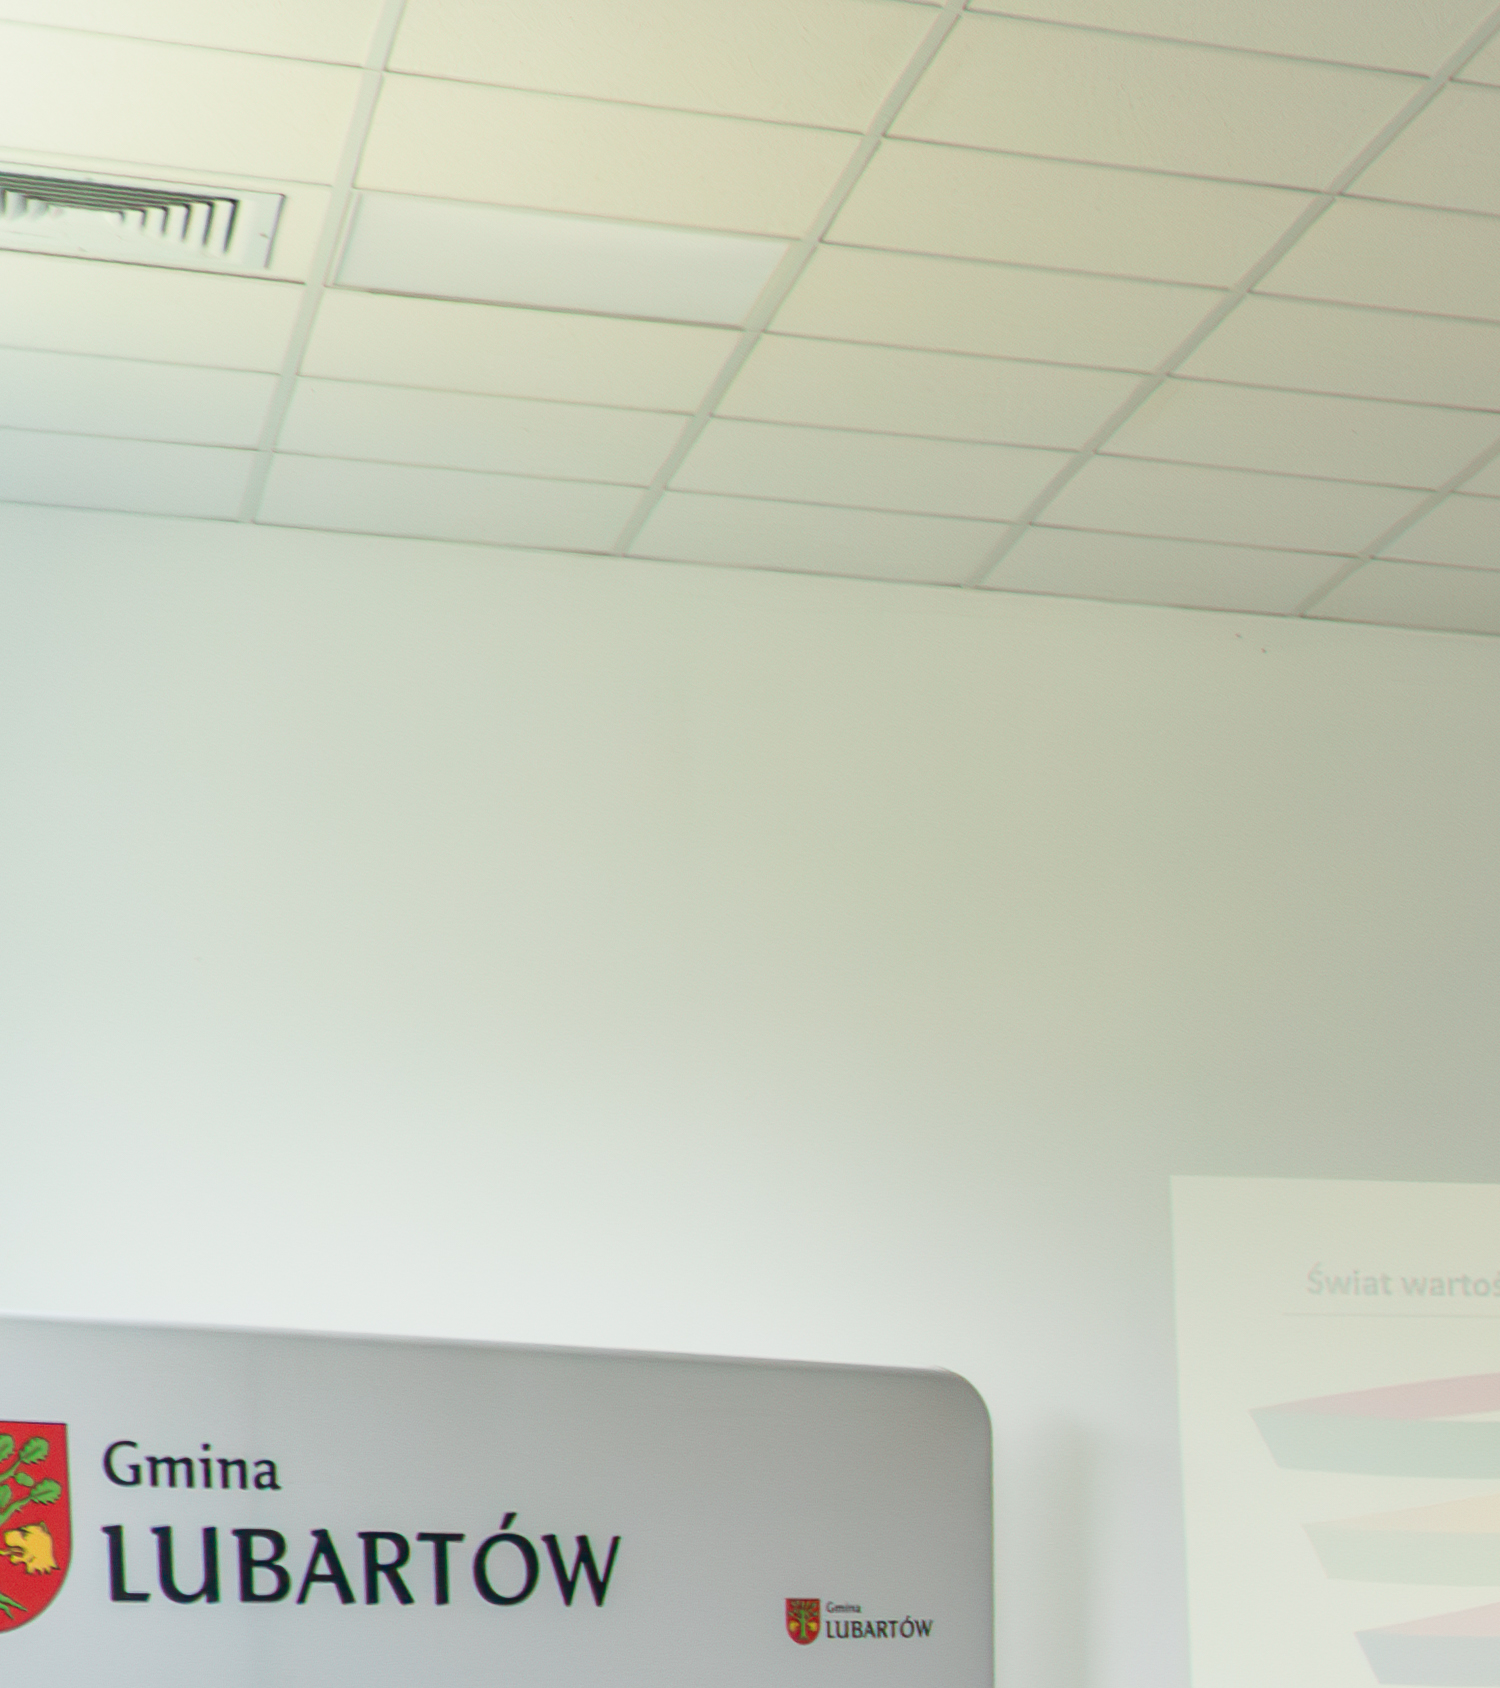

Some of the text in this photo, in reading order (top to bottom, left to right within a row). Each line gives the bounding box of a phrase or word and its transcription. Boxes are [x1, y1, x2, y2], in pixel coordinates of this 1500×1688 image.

[1307, 1261, 1393, 1297] Świat
[102, 1439, 282, 1491] Gmina
[101, 1511, 621, 1608] LUBARTÓW
[825, 1601, 862, 1614] Gmina
[825, 1615, 933, 1639] LUBARTÓW
